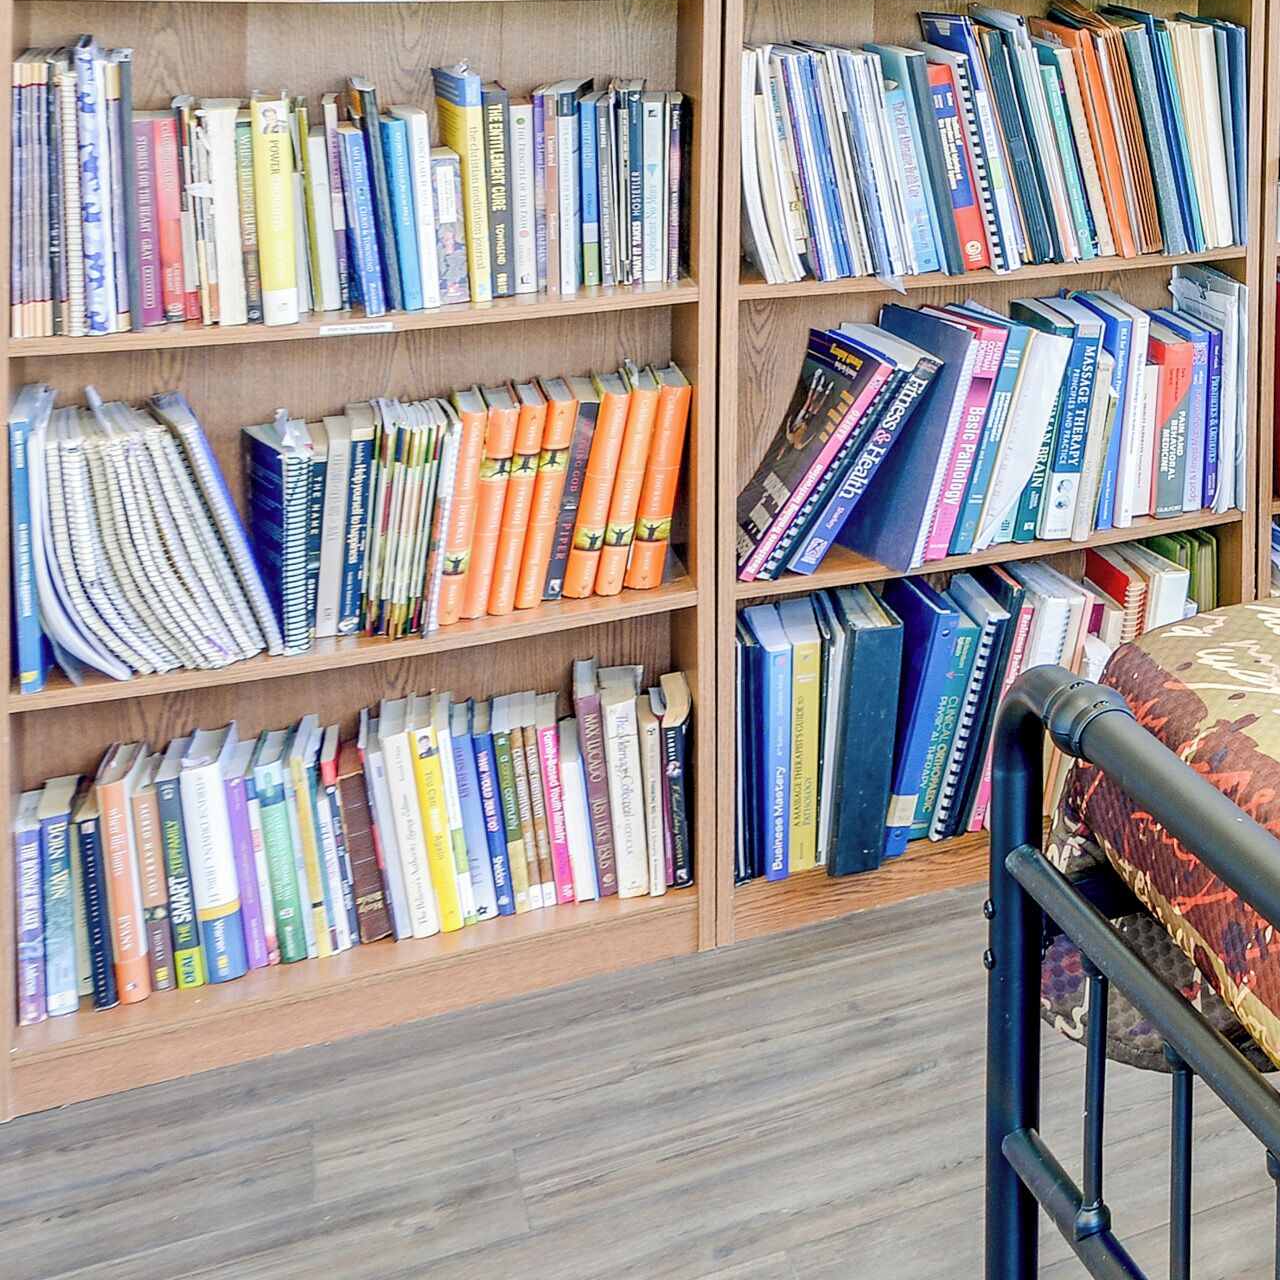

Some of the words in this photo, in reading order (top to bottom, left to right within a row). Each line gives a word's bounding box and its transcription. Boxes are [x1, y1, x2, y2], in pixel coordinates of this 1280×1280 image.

[488, 104, 503, 122] THE
[468, 126, 480, 142] the
[518, 126, 526, 142] THE
[135, 136, 150, 169] STORIES
[239, 135, 252, 167] WHEN
[470, 143, 482, 184] christian
[489, 123, 505, 185] ENTITLEMENT
[518, 143, 527, 181] PRINCIPLE
[137, 171, 151, 187] FOR
[241, 168, 254, 209] HELPING
[519, 183, 527, 191] OF
[631, 171, 640, 216] HOSTETLER
[471, 186, 484, 235] meditation
[492, 187, 507, 211] CURE
[520, 194, 528, 208] THE
[139, 205, 152, 232] HEART
[520, 211, 529, 229] PATH
[631, 221, 640, 248] TAKES
[140, 239, 153, 261] GRAY
[471, 235, 486, 270] journal
[495, 224, 509, 265] TOWNSEND
[632, 259, 640, 279] WHAT
[973, 340, 987, 374] ROBBINS
[982, 340, 994, 371] COTRAN
[990, 341, 1003, 372] KUMAR
[1067, 368, 1080, 408] PRINCIPLES
[1077, 345, 1097, 403] MASSAGE
[882, 377, 928, 431] Fitness
[1064, 411, 1074, 428] AND
[1190, 389, 1203, 452] Management
[875, 430, 892, 443] &
[962, 406, 986, 441] Basic
[1068, 408, 1086, 466] THERAPY
[1178, 411, 1186, 434] PAIN
[1059, 430, 1072, 465] PRACTICE
[1160, 429, 1170, 472] MEDICINE
[1167, 419, 1178, 480] BEHAVIORAL
[1176, 435, 1184, 456] AND
[351, 464, 367, 482] Help
[839, 443, 887, 498] Health
[943, 443, 976, 505] Pathology
[1030, 447, 1047, 489] BRAIN
[1189, 454, 1200, 478] Fitness
[312, 476, 322, 497] THE
[349, 482, 366, 515] yourself
[1187, 484, 1198, 503] Sport
[310, 504, 321, 535] NAME
[350, 516, 363, 524] to
[347, 524, 361, 564] happiness
[555, 523, 571, 561] PIPER
[1014, 614, 1031, 654] Resistance
[1005, 654, 1021, 686] Training
[584, 713, 598, 738] MAX
[939, 696, 958, 742] CLINICAL
[543, 730, 559, 786] Family-Based
[585, 739, 602, 783] LUCADO
[773, 765, 786, 808] Mastery
[921, 744, 948, 813] ORTHOPAEDIC
[550, 787, 562, 811] Youth
[591, 797, 603, 816] JUST
[48, 822, 69, 860] BORN
[553, 812, 565, 844] Ministry
[595, 822, 606, 841] LIKE
[772, 809, 785, 870] Business
[165, 820, 183, 874] STEPFAMILY
[596, 844, 609, 869] JESUS
[49, 869, 69, 900] WIN
[494, 856, 505, 886] Sheldon
[168, 877, 192, 924] SMART
[118, 914, 133, 951] EVANS
[177, 924, 191, 943] THE
[213, 919, 226, 953] Warren
[181, 954, 195, 985] DEAL
